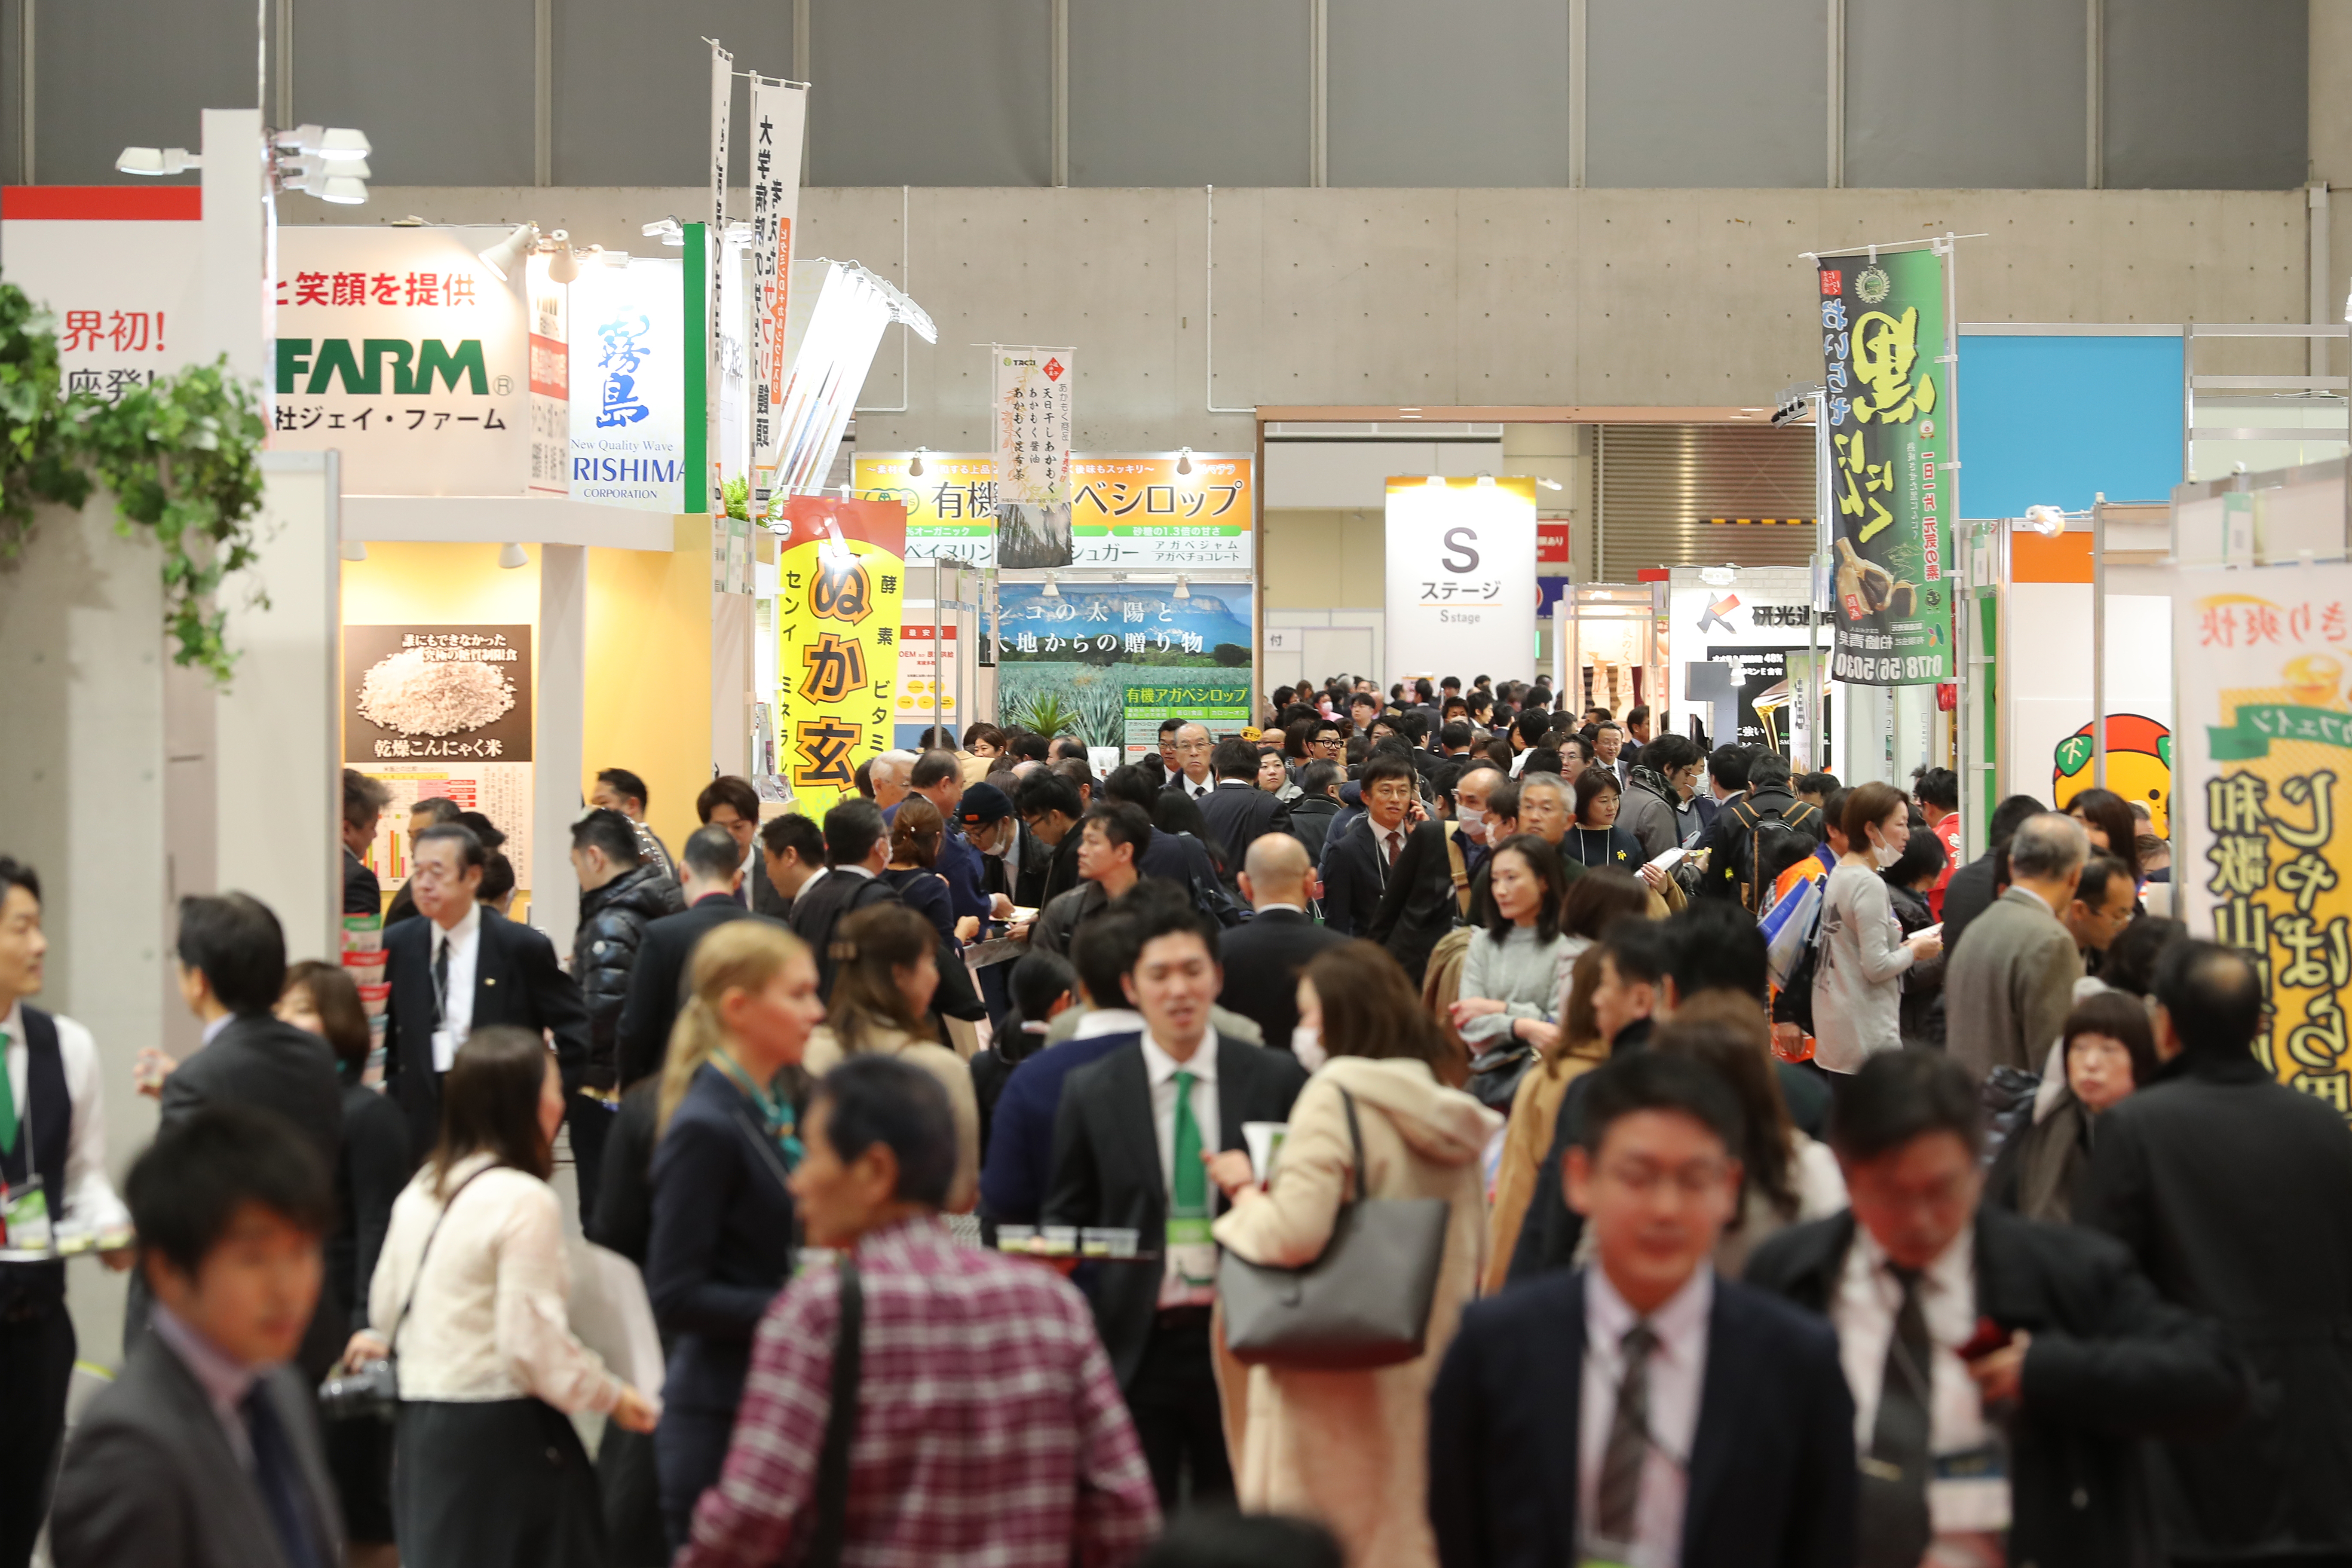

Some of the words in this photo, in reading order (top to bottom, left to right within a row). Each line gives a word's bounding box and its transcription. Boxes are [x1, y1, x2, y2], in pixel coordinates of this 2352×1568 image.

[276, 272, 475, 306] と笑顔を提供
[63, 310, 165, 352] 界初!
[276, 339, 489, 395] FARM
[597, 306, 650, 428] 霧島
[276, 406, 506, 431] 社ジェイ・ファーム
[1029, 387, 1040, 464] あかもく醤油
[570, 439, 596, 450] New
[598, 440, 639, 452] Quality
[643, 441, 674, 452] Wave
[1042, 388, 1057, 493] 天日干しあかもく
[583, 488, 658, 499] CORPORATION
[931, 481, 998, 518] 有機
[1073, 480, 1243, 517] ベシロップ
[1132, 526, 1221, 536] 砂糖の1.3倍の甘さ
[1155, 540, 1238, 550] アガベジャム
[1155, 551, 1240, 562] アガベチョコレート
[1442, 527, 1479, 573] S
[1421, 581, 1501, 600] ステージ
[783, 570, 802, 642] センイ
[877, 575, 897, 646] 酵素
[1440, 610, 1449, 622] S
[1451, 612, 1481, 624] stage
[402, 633, 507, 647] 誰にもできなかった
[1270, 634, 1283, 647] 付
[1764, 653, 1783, 663] 48%
[794, 554, 873, 792] ぬか玄
[1126, 687, 1248, 704] 有機アガベシロップ
[870, 679, 891, 752] ビタミ
[374, 739, 503, 758] 乾燥こんにゃく米
